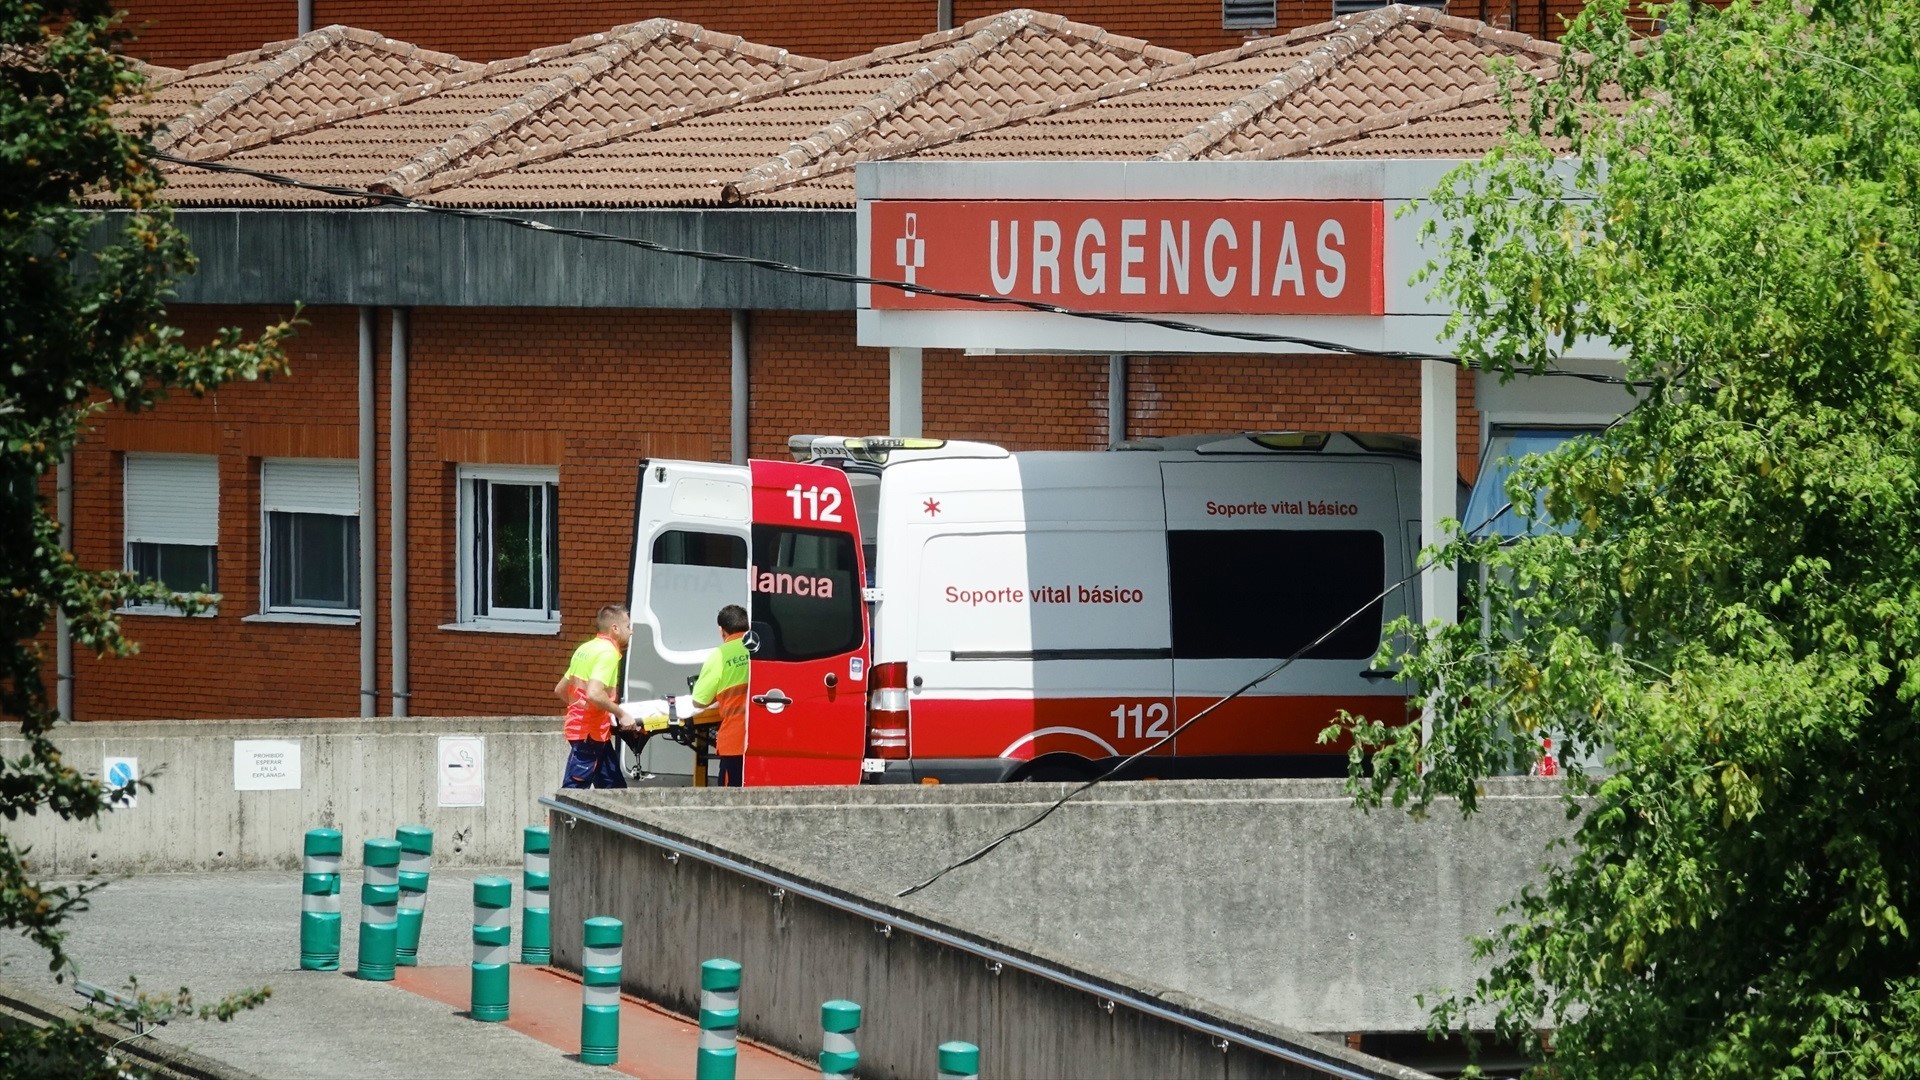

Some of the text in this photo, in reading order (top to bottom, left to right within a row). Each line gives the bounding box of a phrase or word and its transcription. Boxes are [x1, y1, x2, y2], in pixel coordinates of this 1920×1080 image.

[989, 217, 1347, 299] URGENCIAS
[786, 483, 843, 523] 112
[1206, 500, 1359, 518] Soporte vital básico
[945, 584, 1144, 607] Soporte vital básico
[1110, 702, 1169, 739] 112
